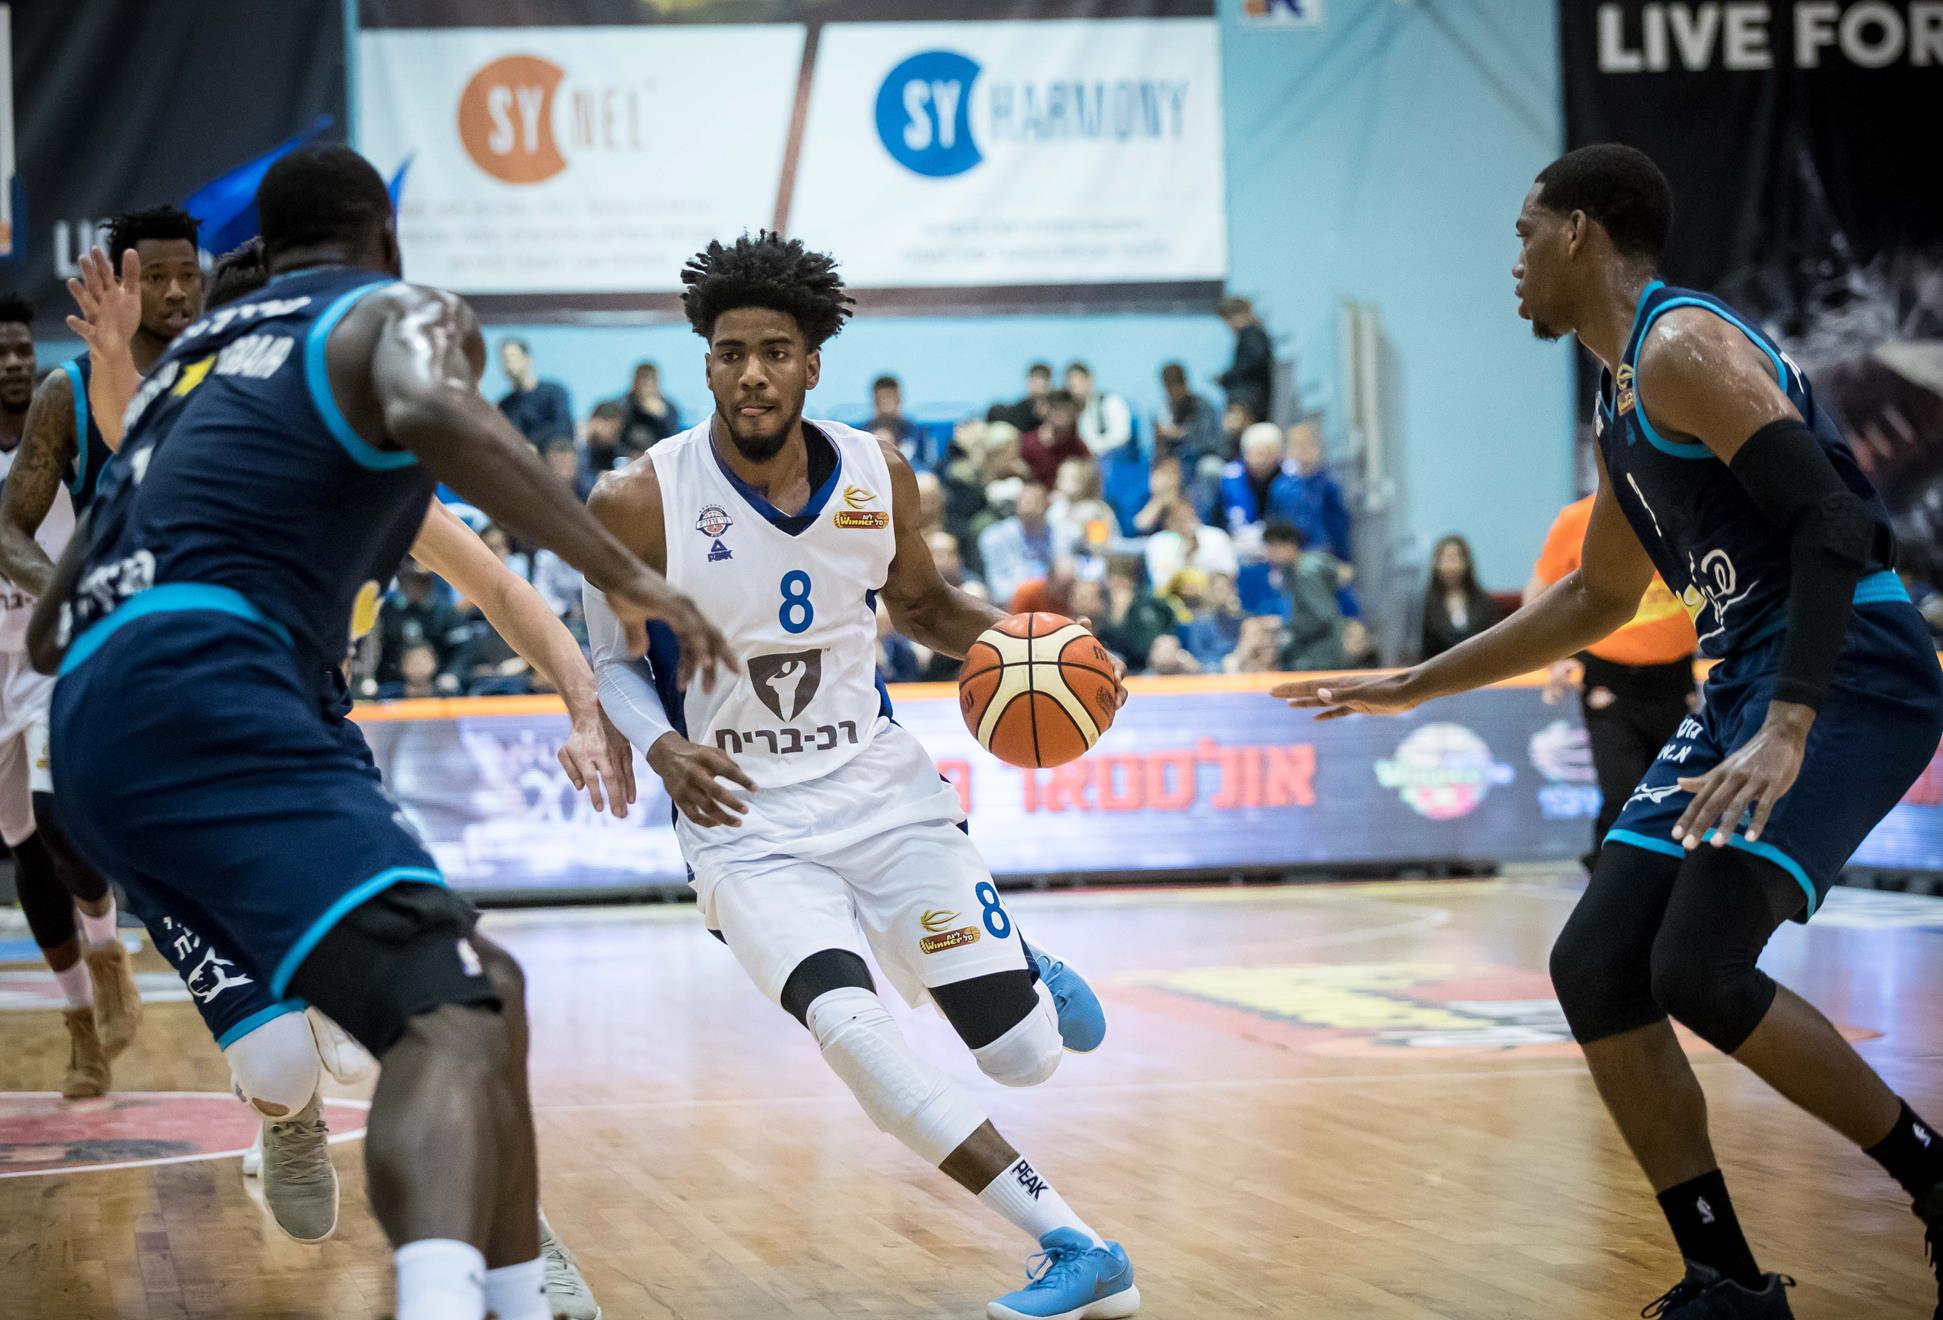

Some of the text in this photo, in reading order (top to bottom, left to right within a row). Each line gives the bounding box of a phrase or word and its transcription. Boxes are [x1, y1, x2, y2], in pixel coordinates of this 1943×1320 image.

[1598, 2, 1943, 72] LIVE FOR
[840, 515, 873, 526] Winner
[779, 570, 814, 634] 8
[975, 881, 1011, 939] 8
[924, 938, 962, 951] Winner
[1012, 1159, 1048, 1200] PEAK
